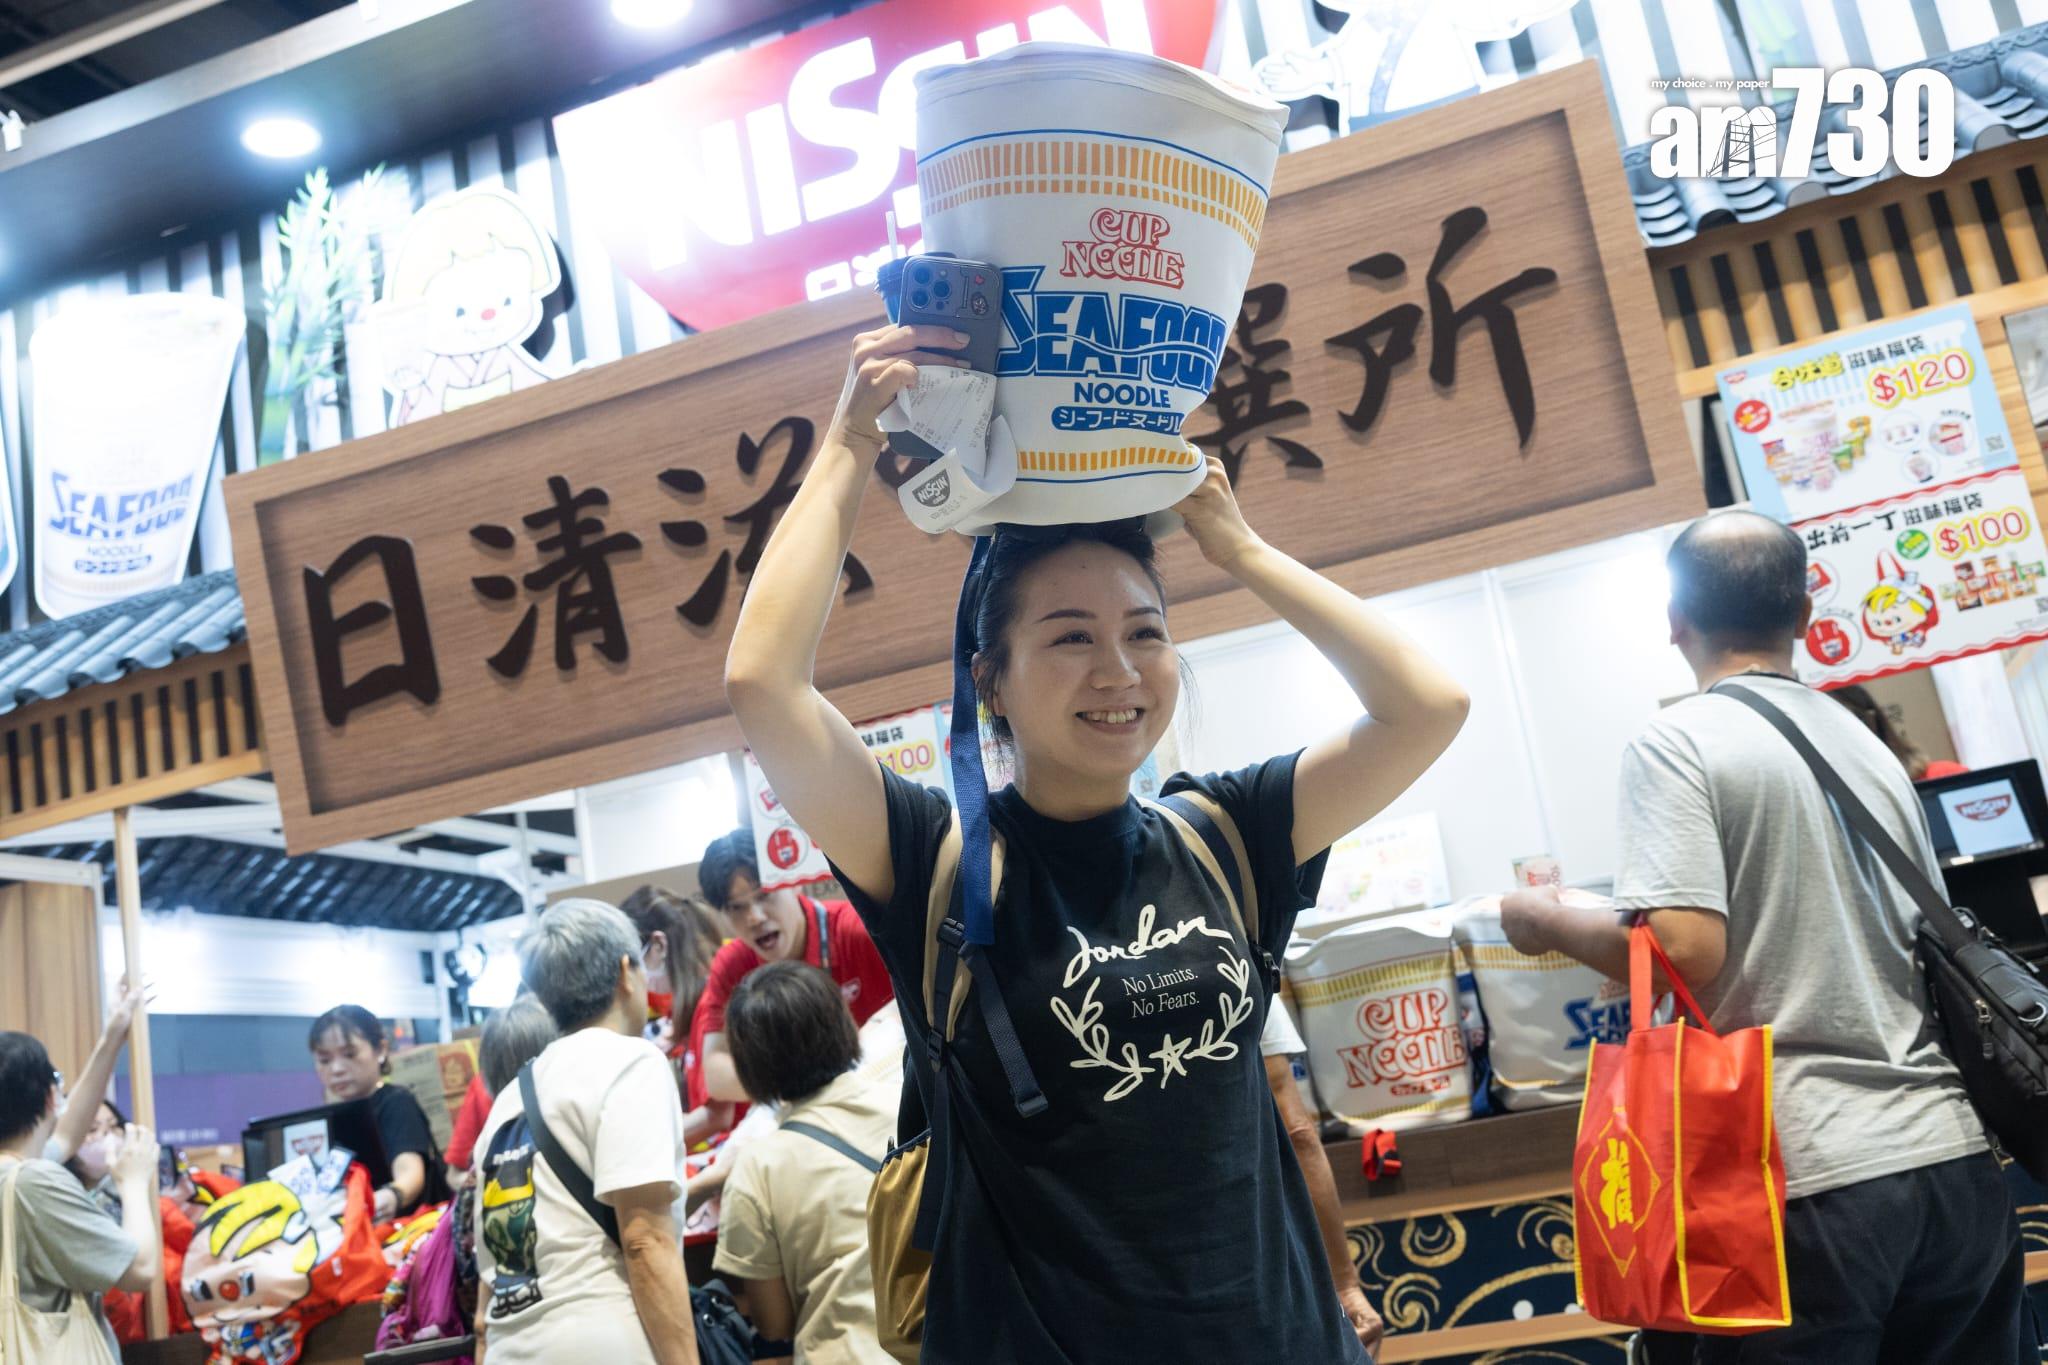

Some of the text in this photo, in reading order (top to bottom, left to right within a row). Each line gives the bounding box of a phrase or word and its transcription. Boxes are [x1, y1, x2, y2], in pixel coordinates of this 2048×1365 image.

[1089, 207, 1170, 246] CUP
[1074, 381, 1171, 408] NOODLE
[1873, 353, 1966, 401] $120
[50, 470, 194, 538] SEAFOOD
[917, 475, 950, 503] NISSIN
[1807, 510, 1897, 551] 出前一丁
[1939, 511, 2024, 553] $100
[1062, 904, 1235, 988] Jordan
[1121, 967, 1199, 996] No Limits.
[1131, 990, 1201, 1018] No Fears.
[1356, 988, 1449, 1042] CUP
